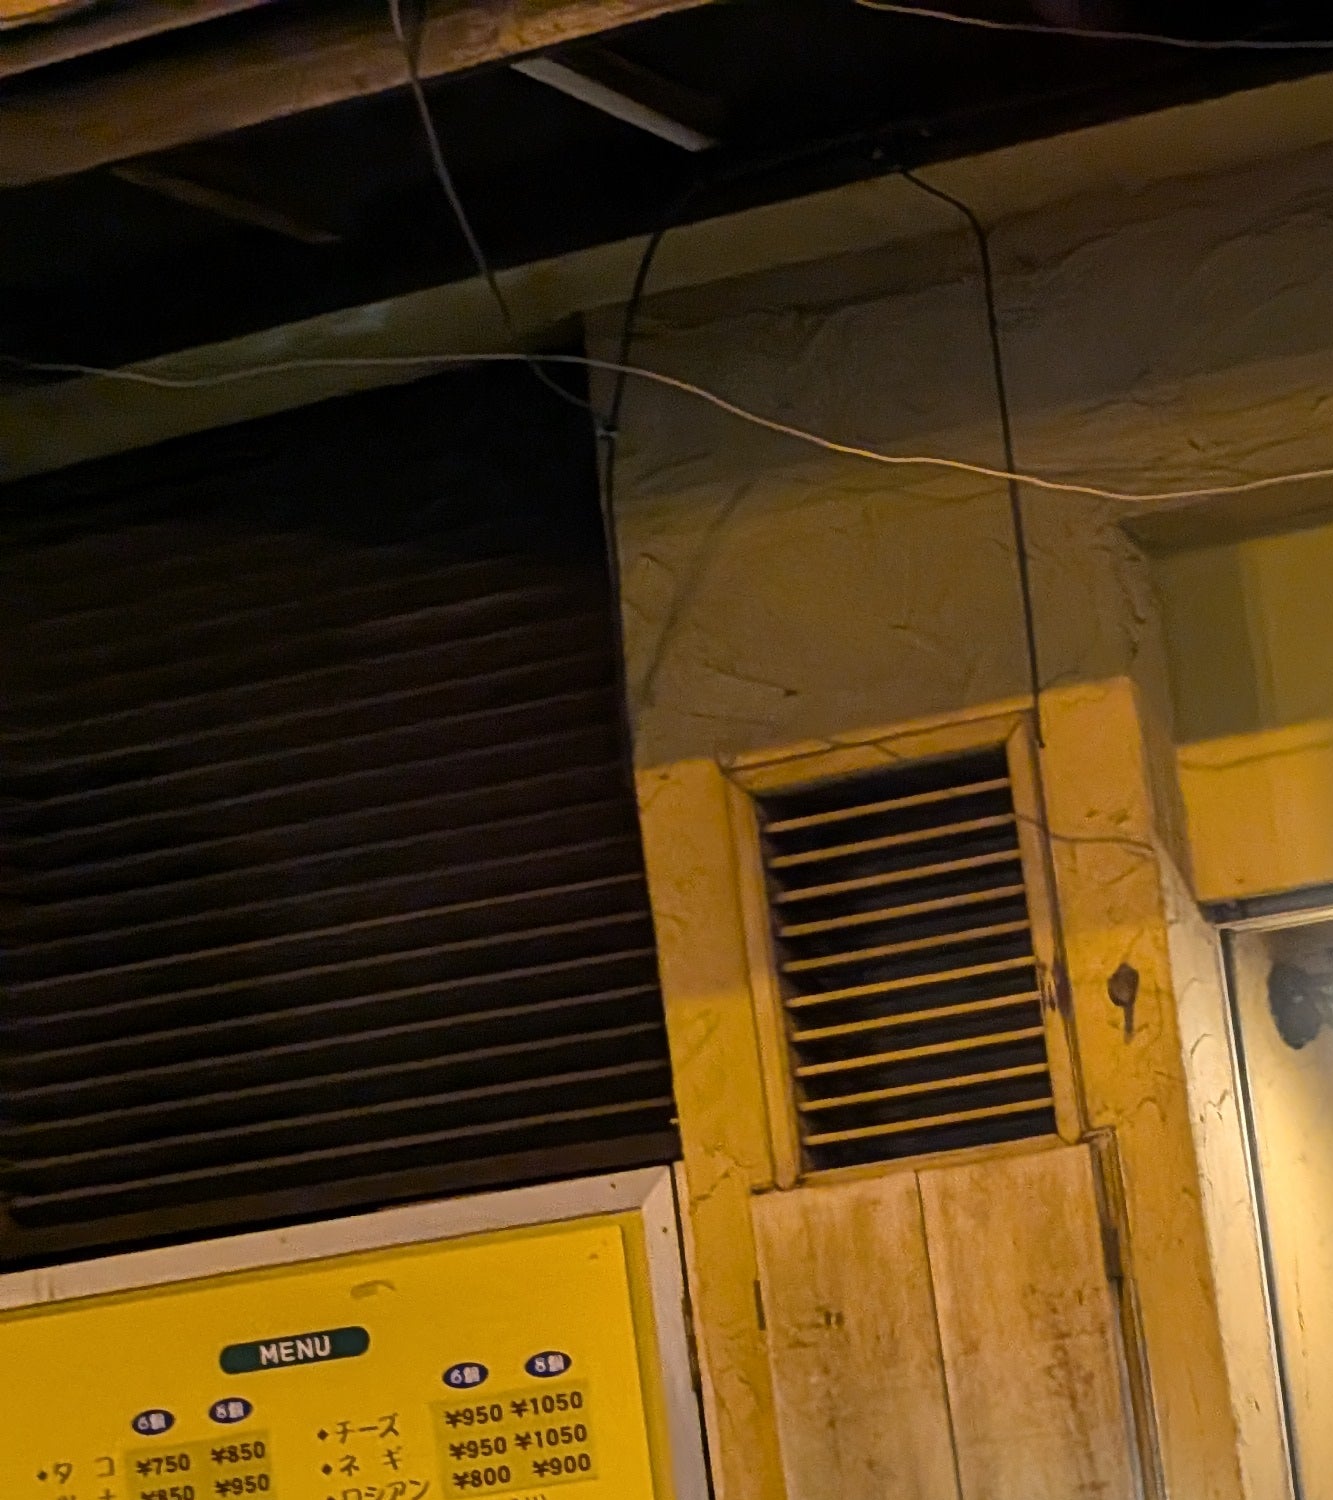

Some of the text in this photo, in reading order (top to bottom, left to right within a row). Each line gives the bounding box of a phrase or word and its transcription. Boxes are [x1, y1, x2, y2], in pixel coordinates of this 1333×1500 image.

[259, 1335, 333, 1366] MENU
[336, 1391, 583, 1443] チーズ ¥950 ¥1050
[52, 1441, 266, 1483] タコ ¥750 ¥850
[340, 1423, 588, 1477] ネギ ¥950 ¥1050
[215, 1474, 271, 1498] ¥950
[452, 1466, 511, 1490] ¥800
[532, 1453, 592, 1478] ¥900
